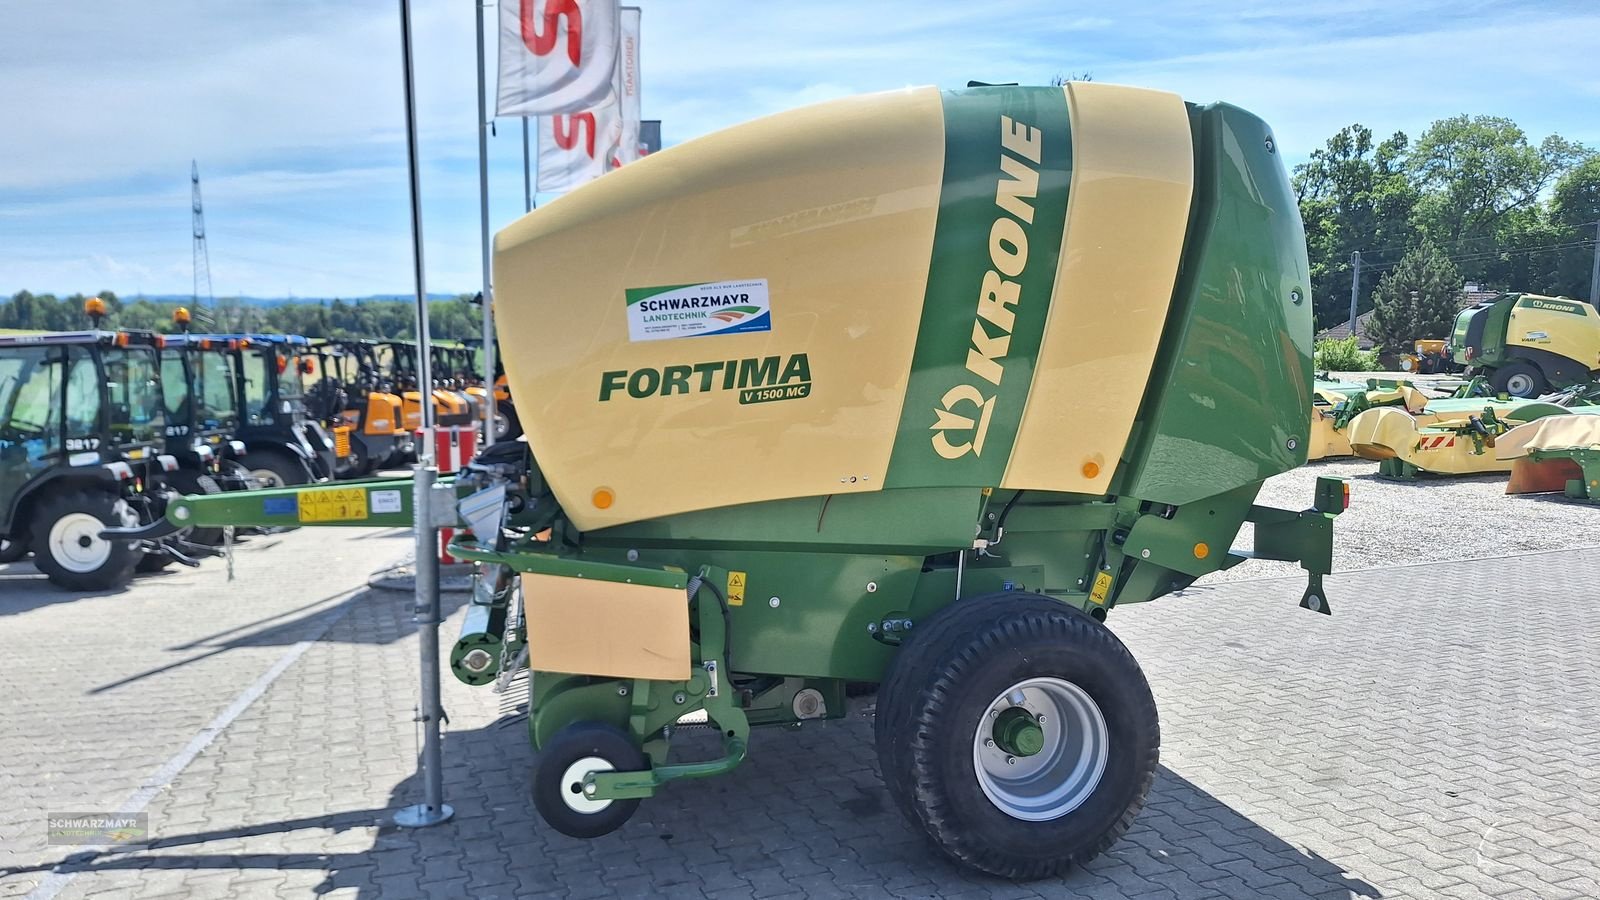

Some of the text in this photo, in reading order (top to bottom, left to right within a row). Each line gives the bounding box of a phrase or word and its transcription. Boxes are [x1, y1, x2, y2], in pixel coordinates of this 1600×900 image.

[965, 115, 1042, 386] KRONE
[640, 293, 749, 312] SCHWARZMAYR
[1542, 303, 1576, 312] KRONE
[643, 311, 707, 323] LANDTECHNIK
[598, 353, 812, 401] FORTIMA
[744, 386, 805, 402] V 1500 MC
